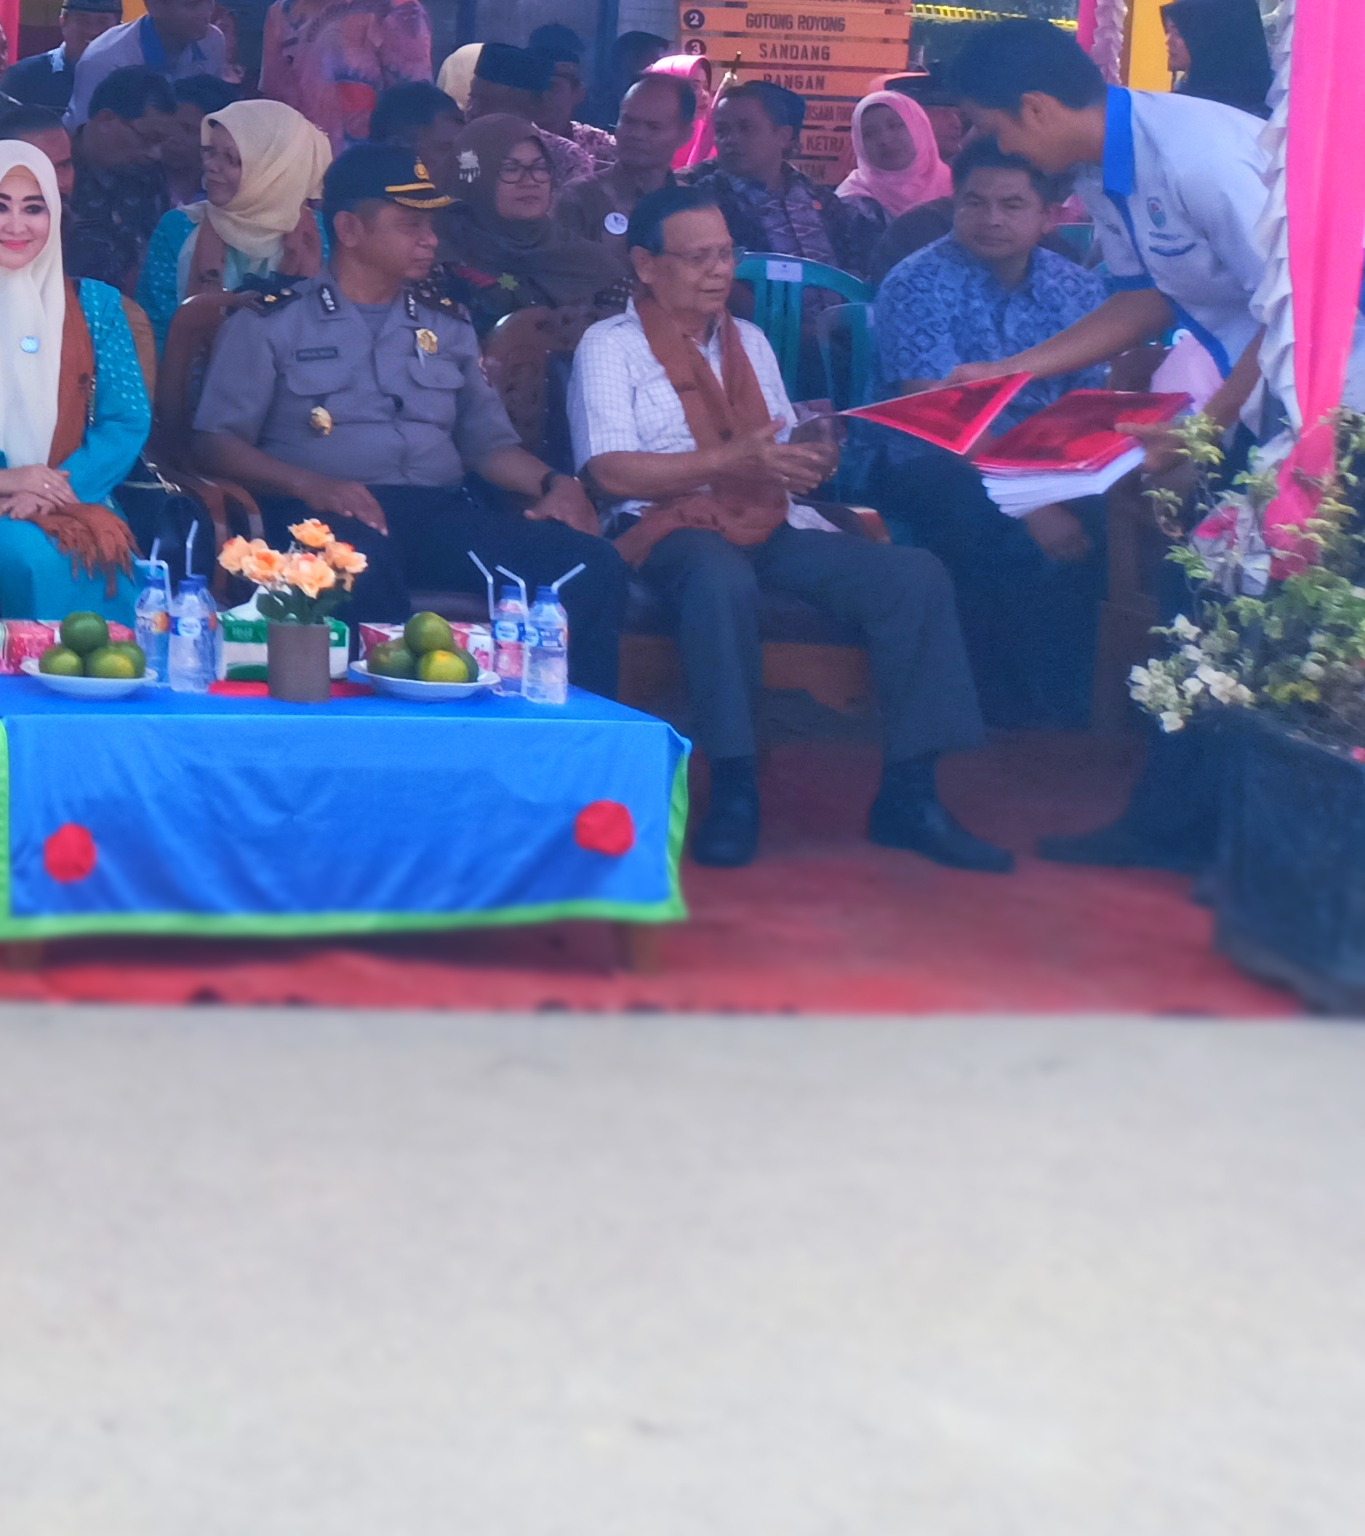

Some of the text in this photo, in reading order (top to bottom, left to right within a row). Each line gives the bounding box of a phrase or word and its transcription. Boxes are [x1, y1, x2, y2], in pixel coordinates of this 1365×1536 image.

[746, 13, 794, 30] GOTONG
[797, 15, 846, 32] ROYONG
[759, 43, 830, 61] SANDANG
